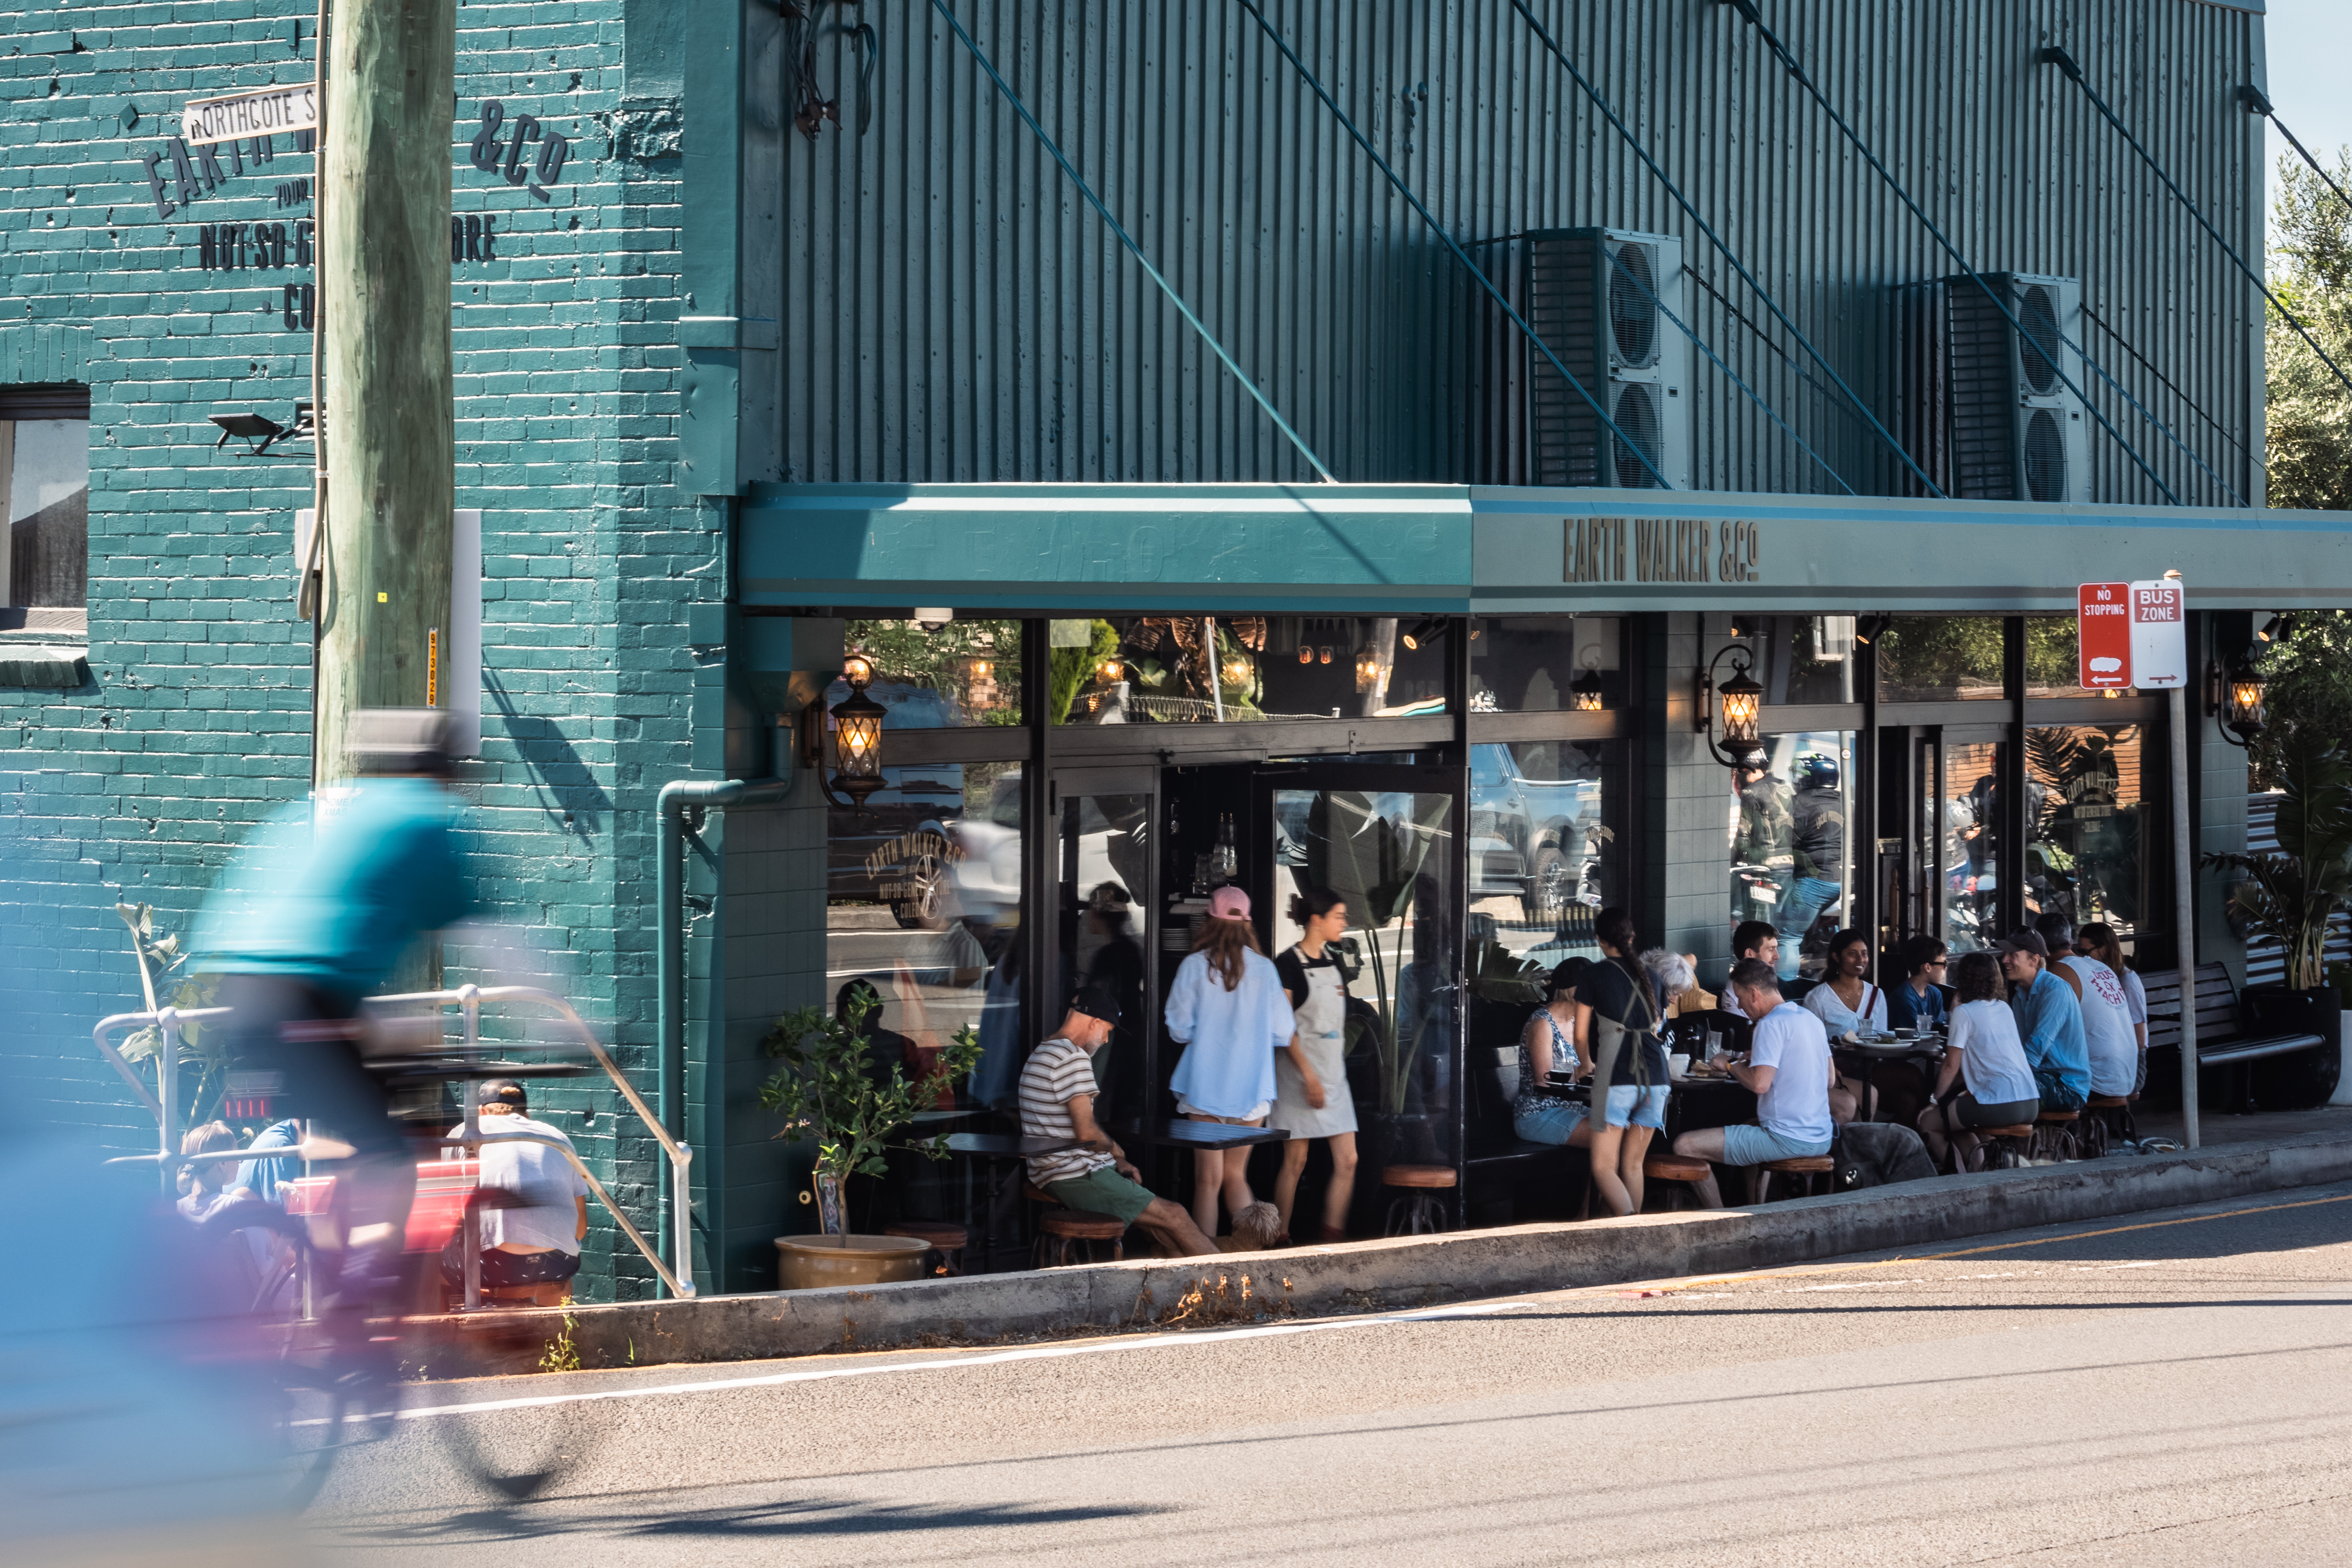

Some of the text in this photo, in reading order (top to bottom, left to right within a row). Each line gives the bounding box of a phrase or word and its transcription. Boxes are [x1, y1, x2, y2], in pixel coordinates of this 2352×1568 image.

[274, 178, 309, 209] YOUR
[200, 221, 315, 272] NOT-SO-G
[1563, 518, 1626, 582] EARTH
[1635, 519, 1711, 582] WALKER
[2097, 590, 2111, 600] NO
[2140, 590, 2174, 604] BUS
[2085, 604, 2125, 616] STOPPING
[2141, 607, 2174, 621] ZONE
[865, 838, 898, 880] EARTH
[901, 832, 942, 859] WALKER
[879, 881, 930, 899] NOT-SO-GEN
[2091, 970, 2114, 980] DEUS
[2091, 978, 2125, 1005] MACHI
[2104, 982, 2116, 992] EX
